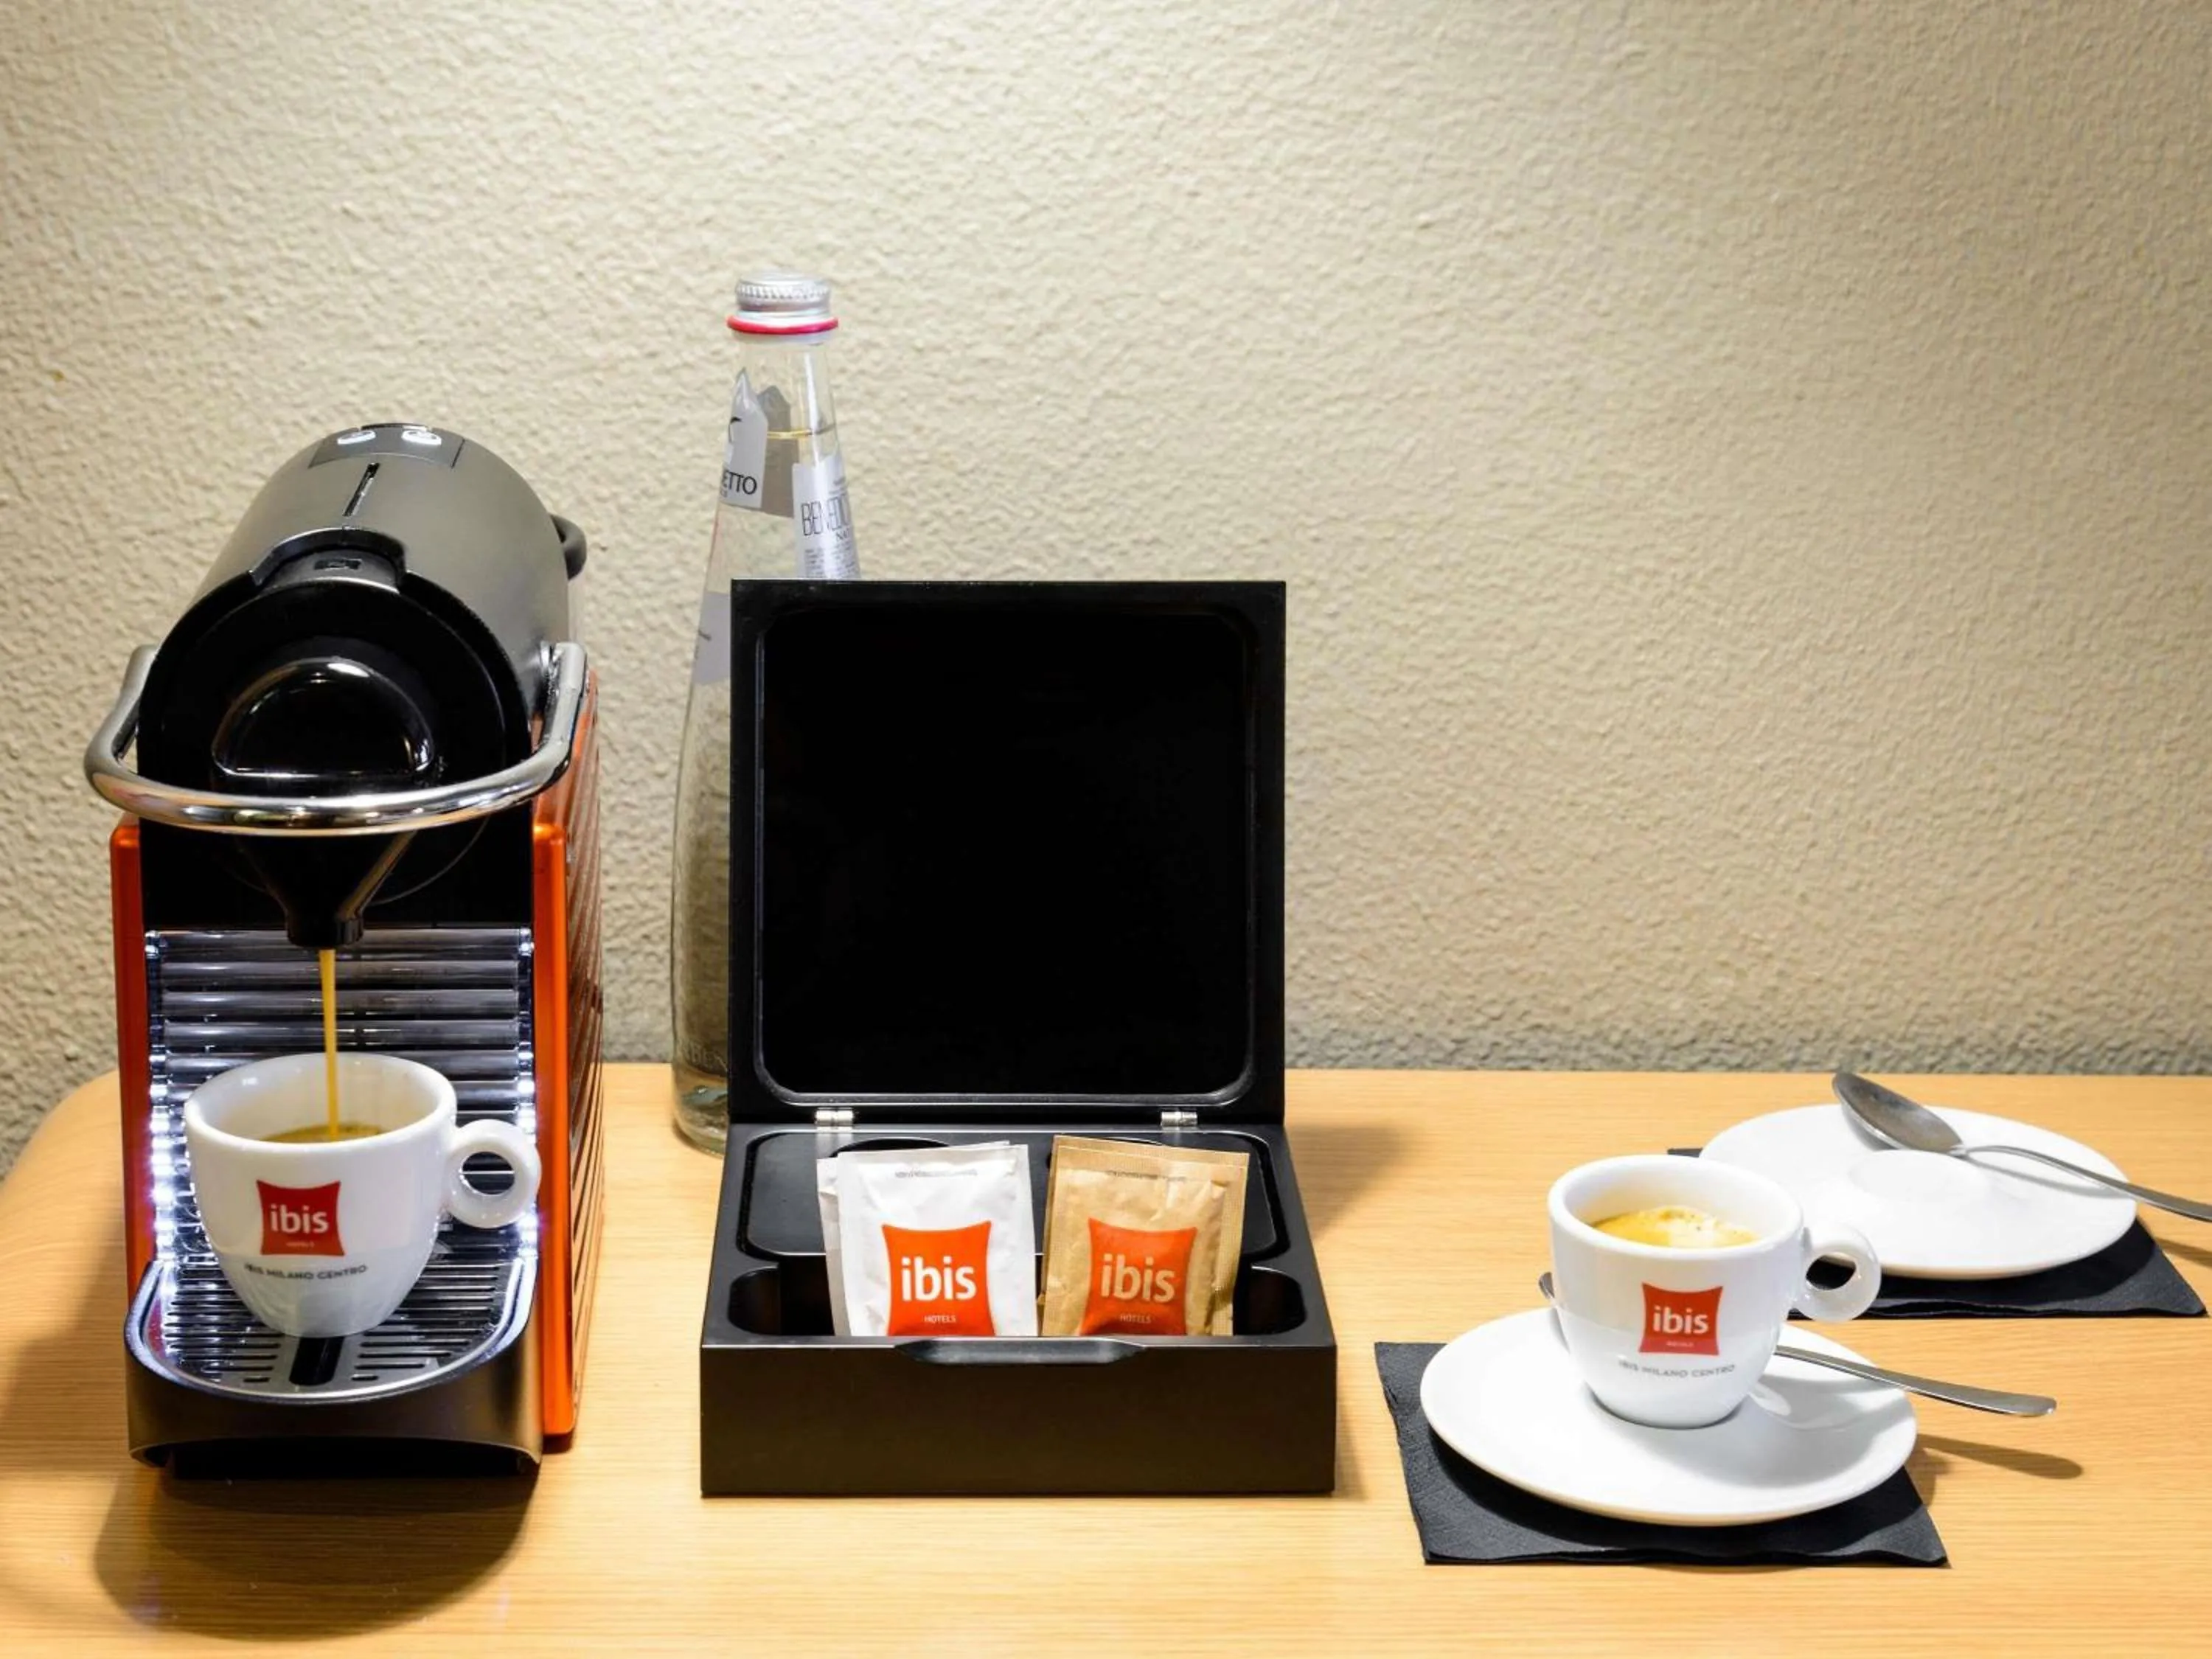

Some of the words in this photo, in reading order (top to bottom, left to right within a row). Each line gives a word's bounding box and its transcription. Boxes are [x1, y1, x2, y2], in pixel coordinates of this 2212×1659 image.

[269, 1203, 330, 1234] ibis
[316, 1264, 368, 1280] CENTRO
[902, 1256, 977, 1301] ibis
[1101, 1253, 1175, 1303] ibis
[923, 1314, 956, 1324] HOTELS
[1119, 1313, 1152, 1324] HOTELS
[1653, 1306, 1709, 1335] ibis
[1641, 1366, 1688, 1378] MILANO
[1691, 1364, 1736, 1378] CENTRO
